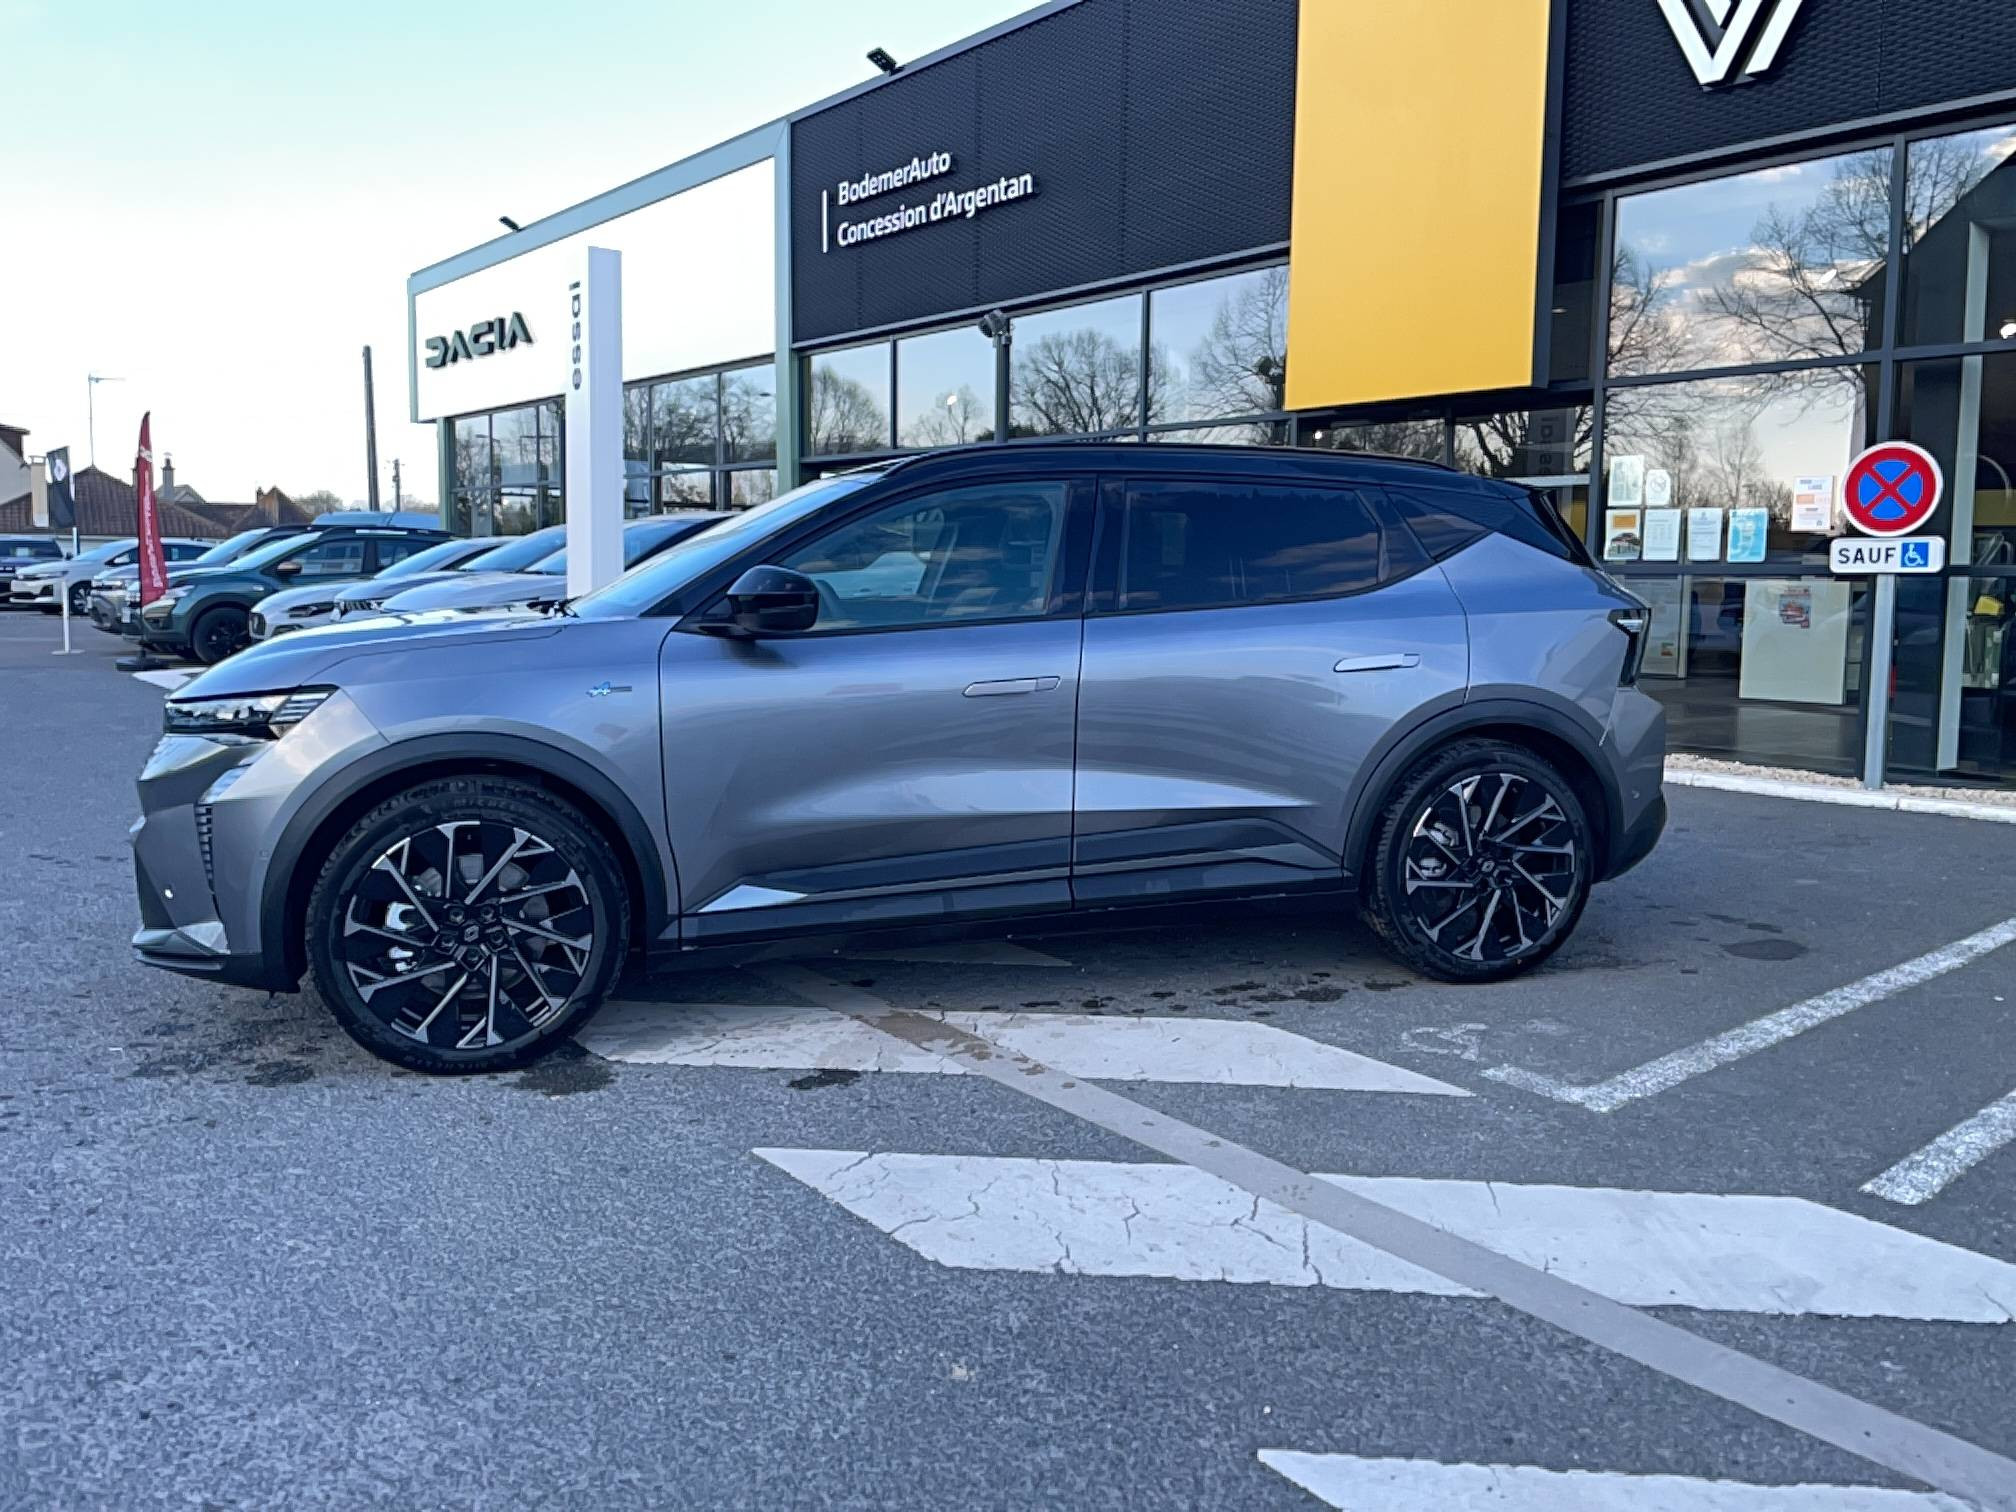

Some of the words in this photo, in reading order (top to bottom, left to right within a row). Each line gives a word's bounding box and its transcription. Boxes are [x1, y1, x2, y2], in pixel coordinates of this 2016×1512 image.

[838, 151, 950, 205] BodemerAuto
[837, 204, 927, 247] Concession
[930, 172, 1033, 219] d'Argentan
[425, 310, 534, 369] DACIA
[1838, 546, 1896, 564] SAUF
